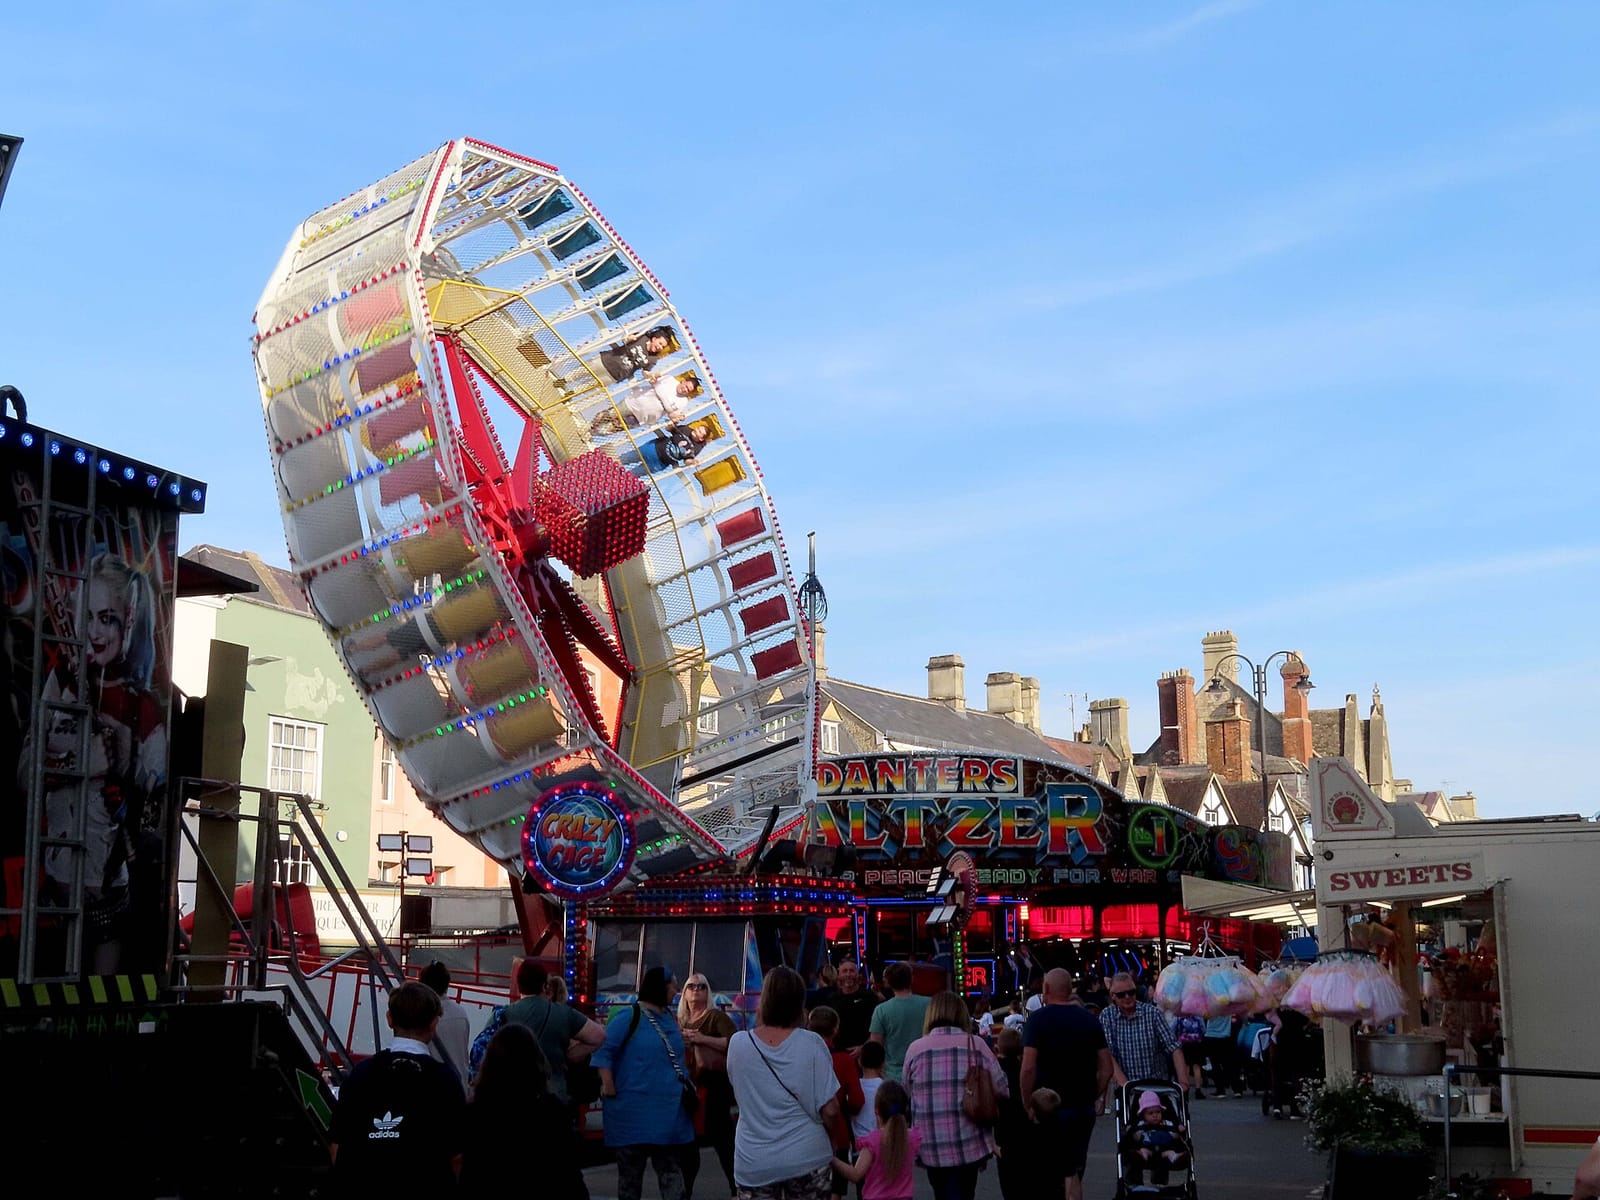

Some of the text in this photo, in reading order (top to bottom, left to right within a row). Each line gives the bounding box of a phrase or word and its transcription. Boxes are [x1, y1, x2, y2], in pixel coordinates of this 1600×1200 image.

[817, 758, 1018, 794] DANTERS
[542, 813, 617, 843] CRAZY
[798, 781, 1107, 856] ALTZER
[547, 844, 606, 871] CAGE
[864, 869, 932, 886] PEAC
[976, 868, 1042, 885] EADY
[1053, 868, 1101, 885] FOR
[1111, 868, 1158, 884] WAR
[1330, 862, 1473, 892] SWEETS
[368, 1130, 400, 1139] adidas
